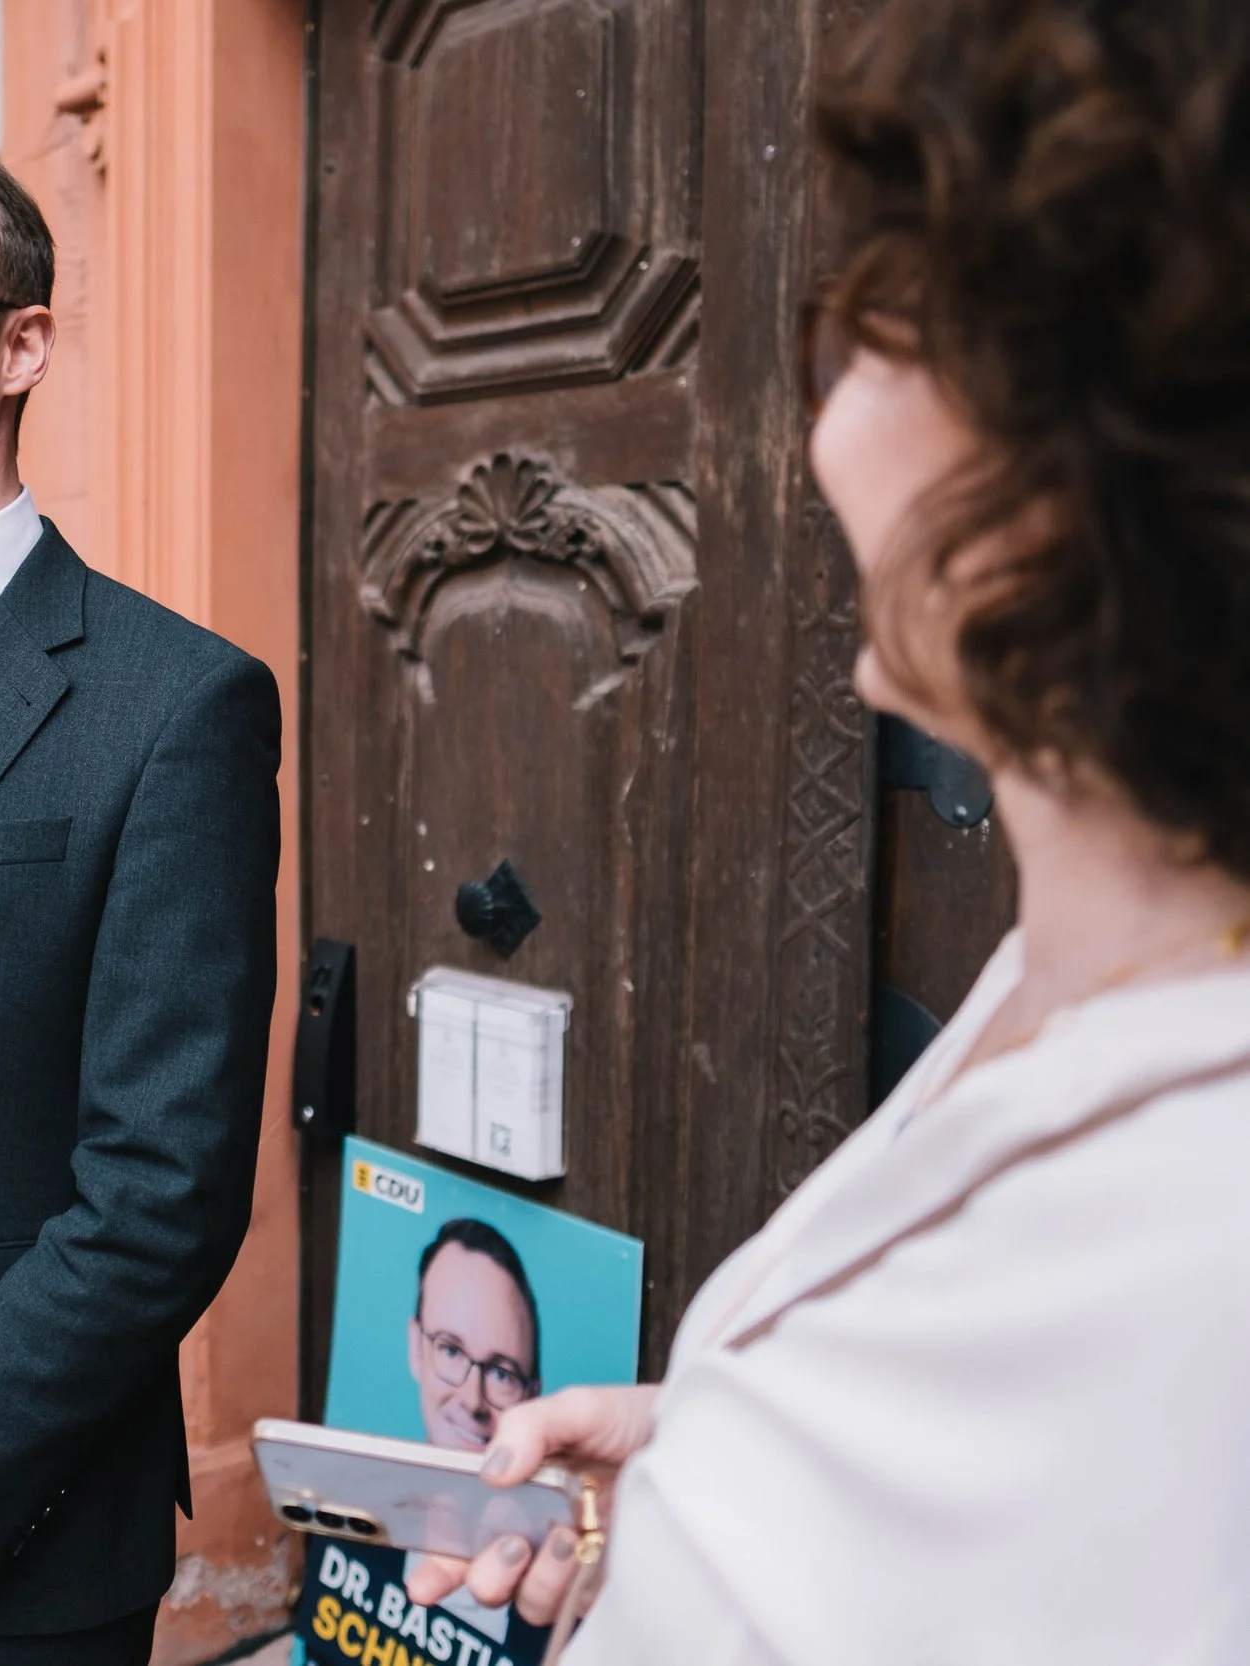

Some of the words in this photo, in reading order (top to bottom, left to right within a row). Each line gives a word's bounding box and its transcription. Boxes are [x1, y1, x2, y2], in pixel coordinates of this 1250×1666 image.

[374, 1173, 420, 1206] CDU
[318, 1544, 374, 1613] DR.
[377, 1581, 514, 1666] BASTI
